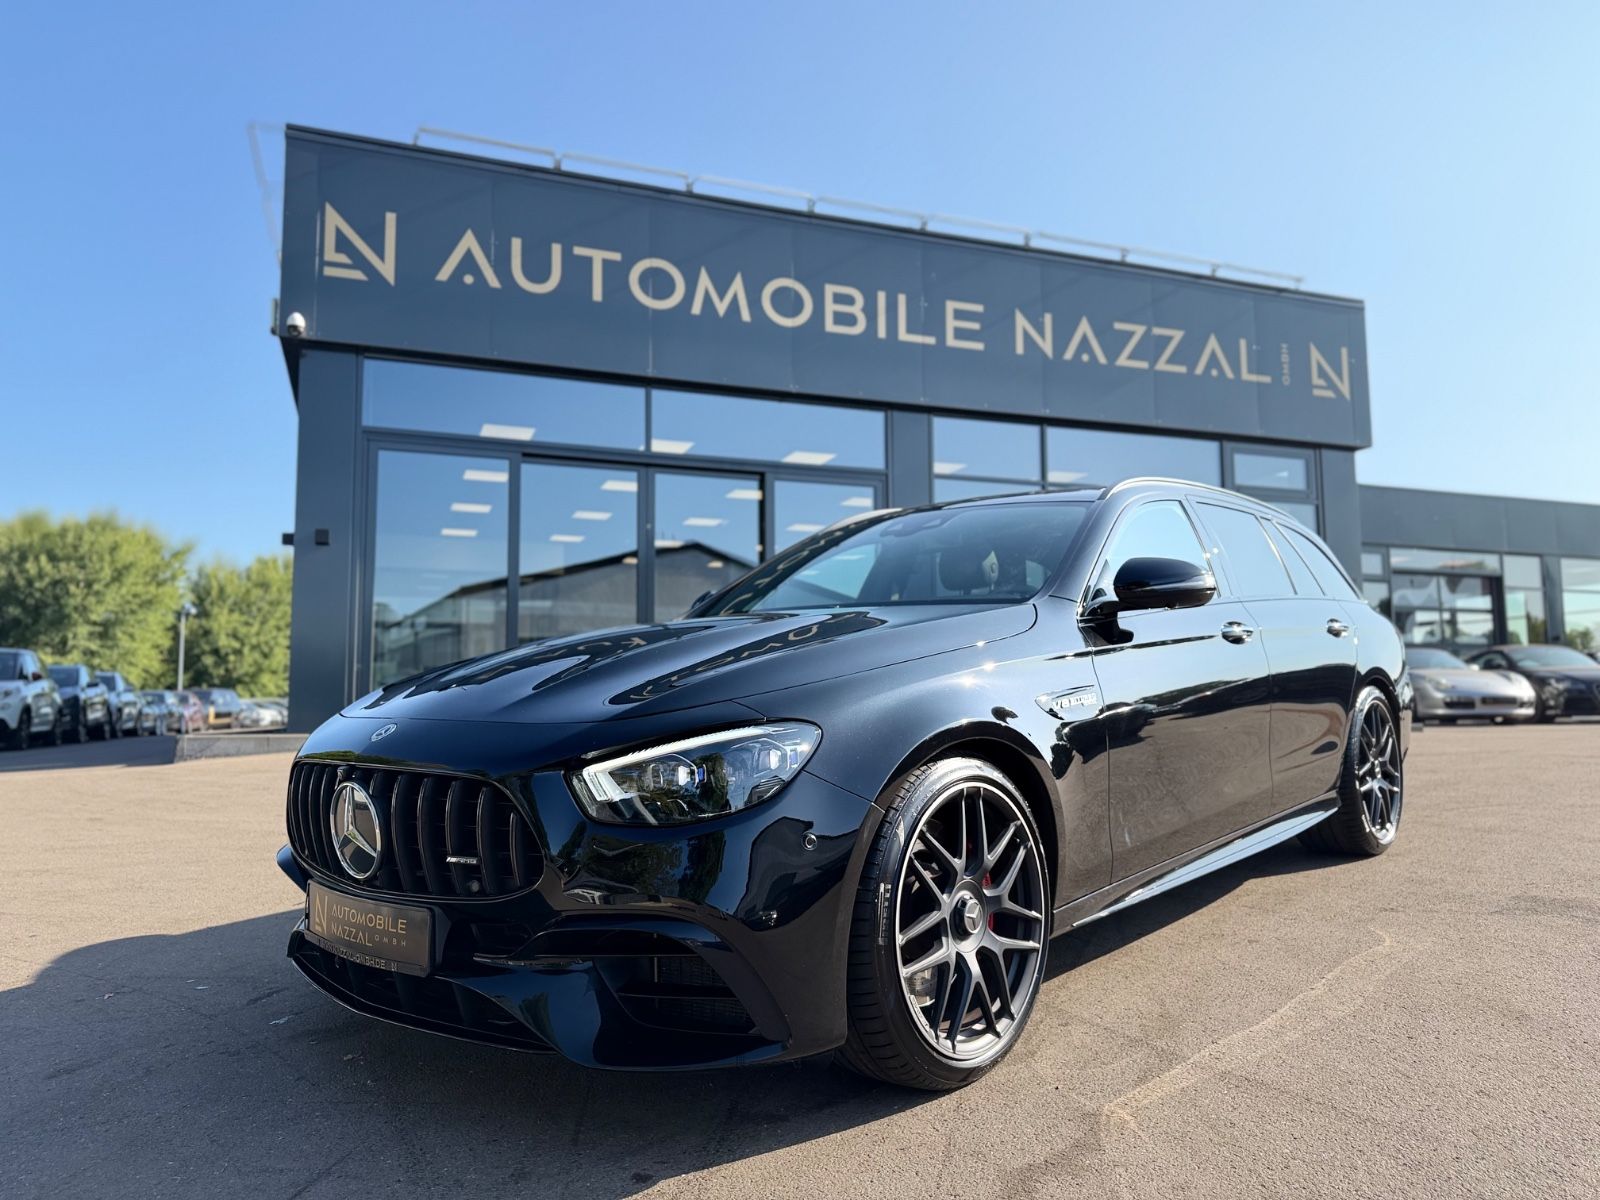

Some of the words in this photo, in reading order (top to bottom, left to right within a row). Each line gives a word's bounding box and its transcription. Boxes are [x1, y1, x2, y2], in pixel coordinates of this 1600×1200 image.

[435, 228, 985, 352] AUTOMOBILE
[1015, 308, 1272, 384] NAZZAL
[331, 904, 407, 934] AUTOMOBILE
[331, 922, 373, 946] NAZZAL
